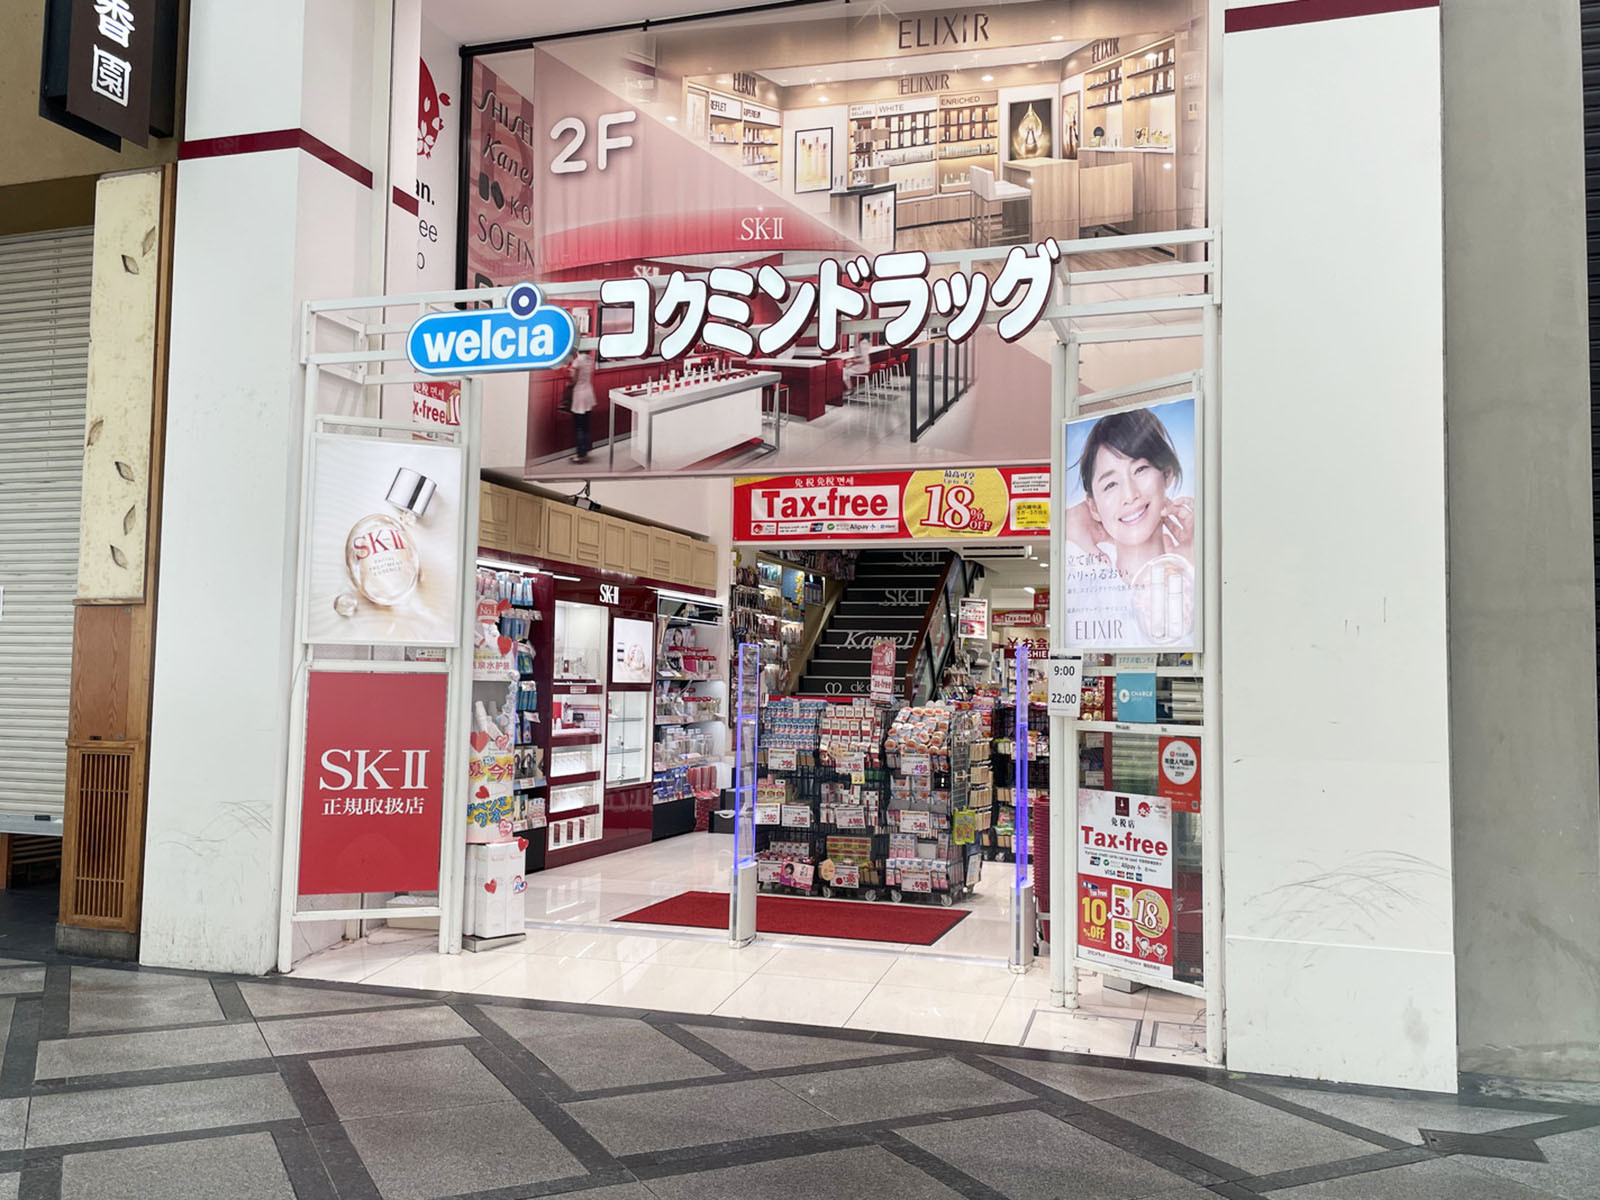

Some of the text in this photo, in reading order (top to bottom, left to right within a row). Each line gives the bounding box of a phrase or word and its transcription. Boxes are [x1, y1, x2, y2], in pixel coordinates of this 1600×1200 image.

[898, 13, 989, 49] ELIXIR
[1091, 37, 1120, 63] ELIXIR
[732, 72, 757, 97] ELIXIR
[898, 74, 950, 95] ELIXIR
[878, 104, 905, 113] WHITE
[941, 95, 981, 106] ENRICHED
[550, 110, 637, 174] 2F
[740, 216, 785, 241] SK-II
[598, 237, 1061, 359] コクミンドラッグ
[422, 319, 554, 363] welcia
[761, 487, 889, 519] Tax-free
[920, 483, 974, 530] 18
[968, 520, 993, 532] OFF
[1075, 619, 1123, 640] ELIXIR
[1054, 665, 1076, 677] 9:00
[1051, 693, 1077, 704] 22:00
[319, 748, 431, 791] SK-II
[320, 796, 425, 815] 正規取扱店
[1080, 825, 1168, 857] Tax-free
[1104, 868, 1116, 876] VISA
[1081, 896, 1107, 926] 10
[1114, 896, 1126, 917] 5
[1134, 898, 1159, 930] 18
[1114, 931, 1126, 951] 8
